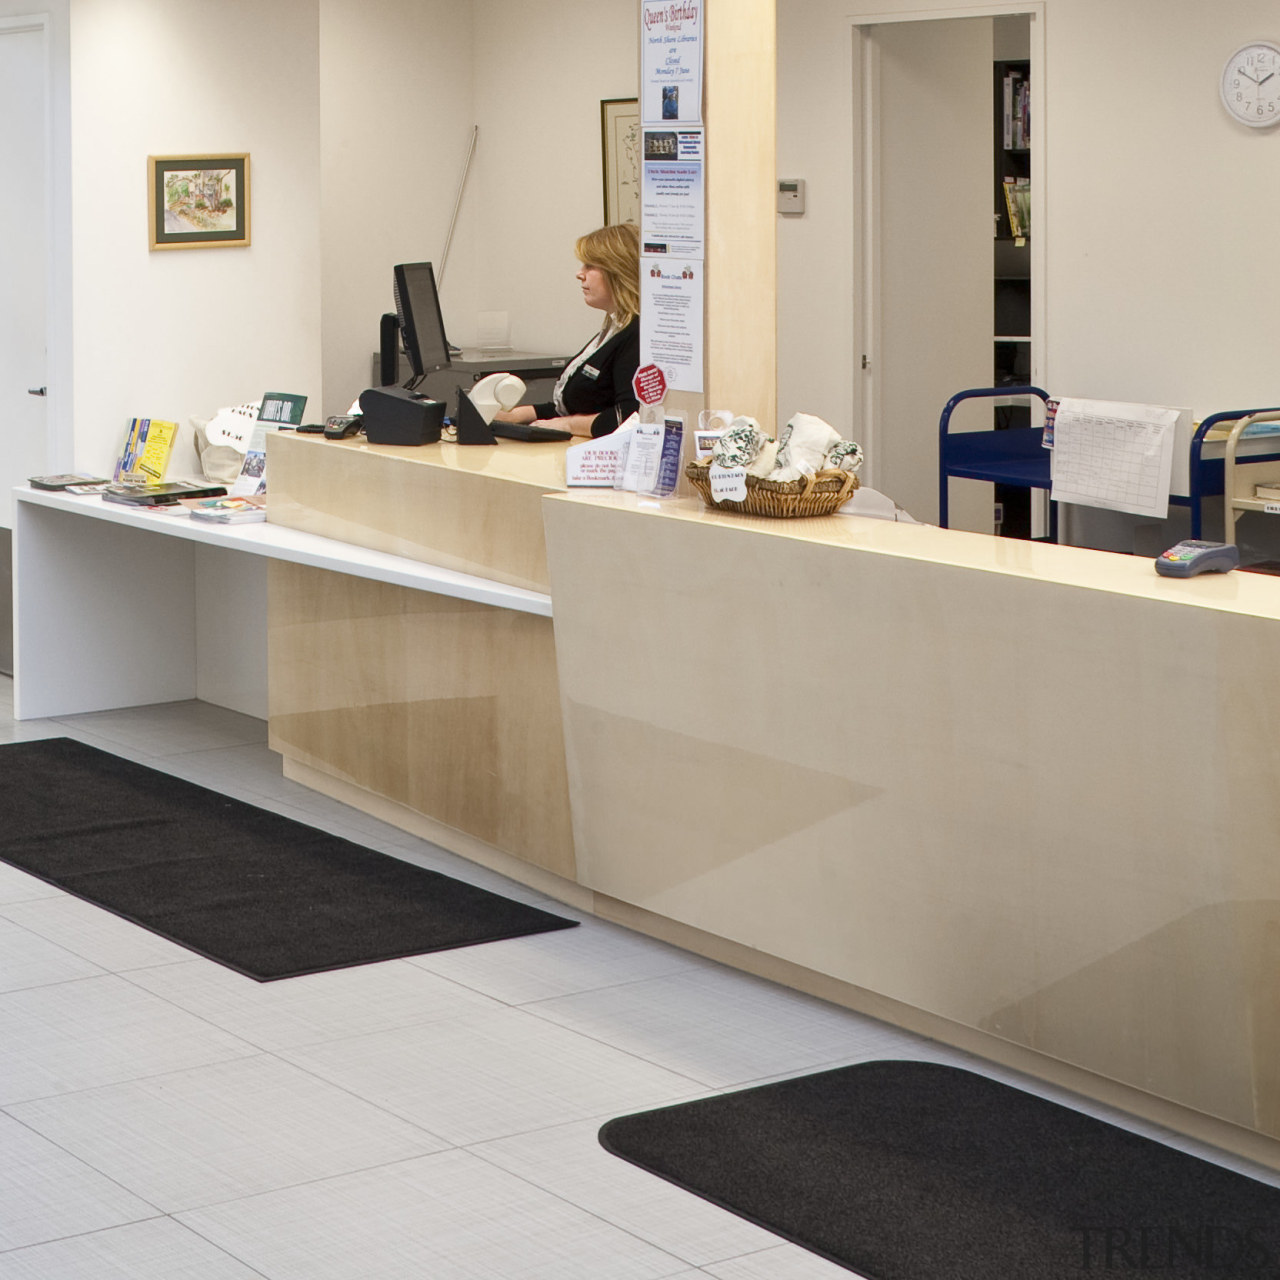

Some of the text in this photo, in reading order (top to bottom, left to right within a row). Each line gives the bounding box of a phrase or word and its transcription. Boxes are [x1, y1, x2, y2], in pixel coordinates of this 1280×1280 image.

[644, 0, 697, 31] Queen's Birthday
[1257, 53, 1264, 63] 12
[1233, 79, 1240, 89] 9
[1236, 92, 1242, 102] 8
[1257, 105, 1263, 115] 6
[1268, 102, 1274, 112] 5
